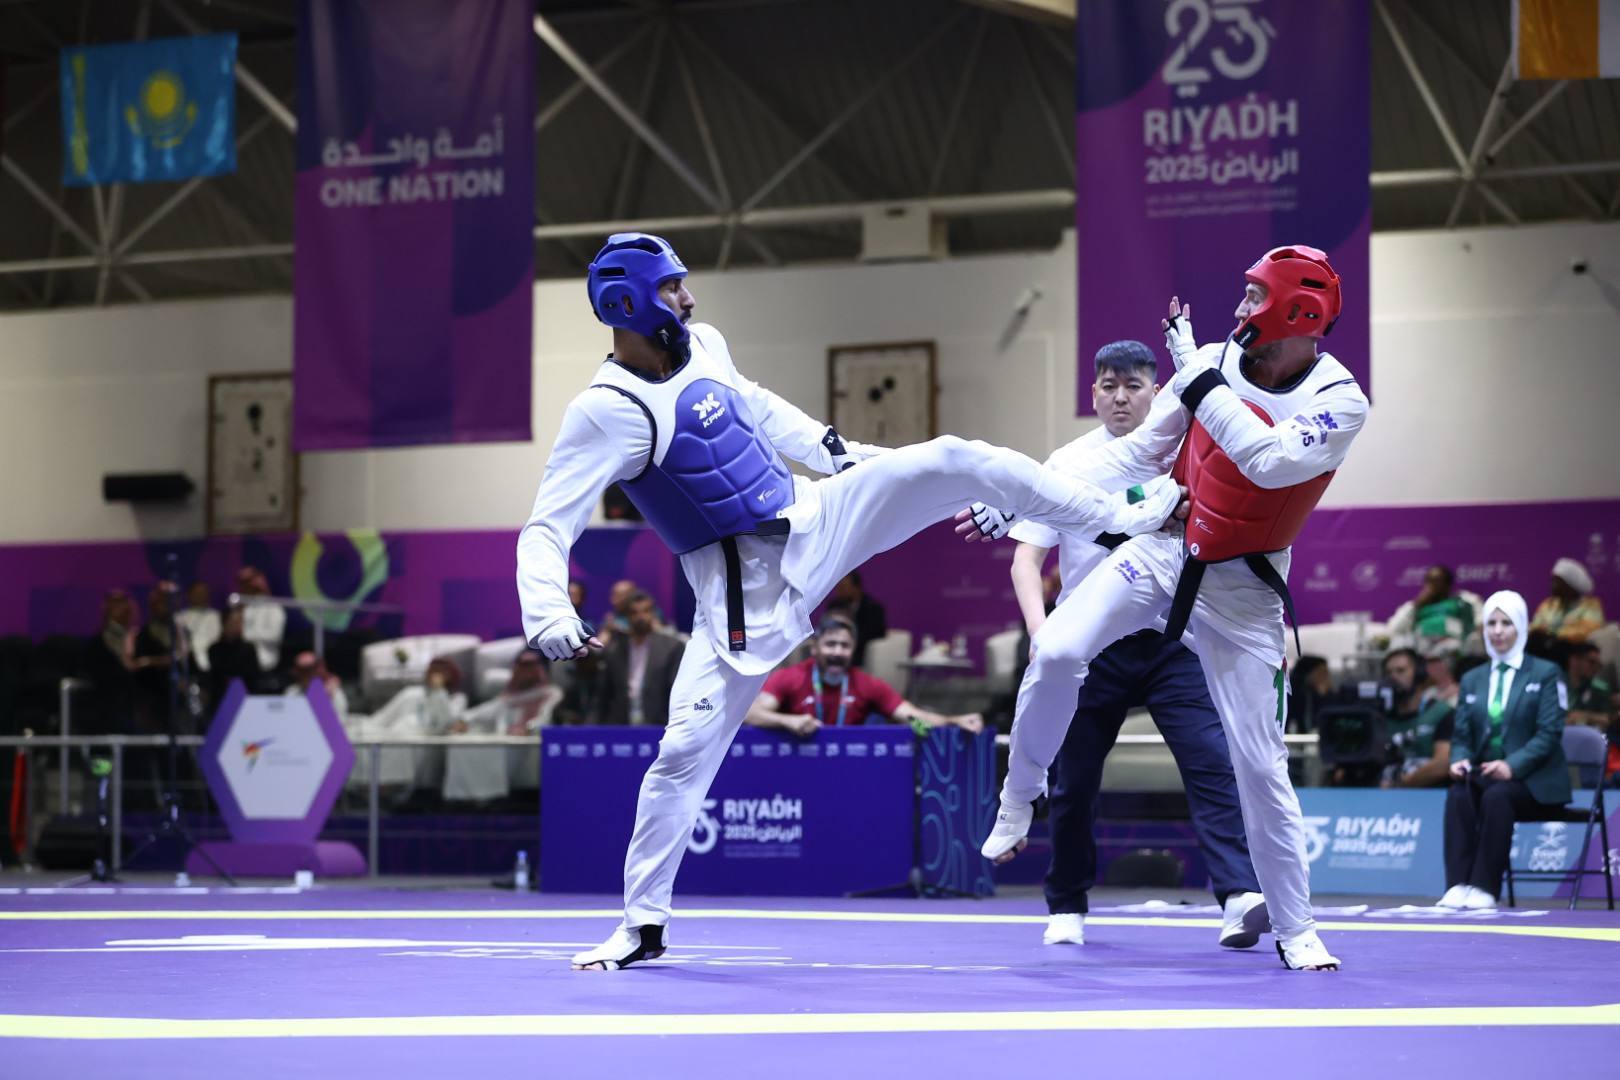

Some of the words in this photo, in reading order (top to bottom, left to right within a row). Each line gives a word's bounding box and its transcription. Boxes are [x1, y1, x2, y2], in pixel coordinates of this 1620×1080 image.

[1144, 95, 1299, 150] RIYADH
[320, 178, 384, 208] ONE
[389, 168, 504, 202] NATION
[702, 406, 726, 428] KPNP
[694, 703, 713, 711] Daedo
[723, 794, 802, 823] RIYADH
[1335, 813, 1421, 838] RIYADH
